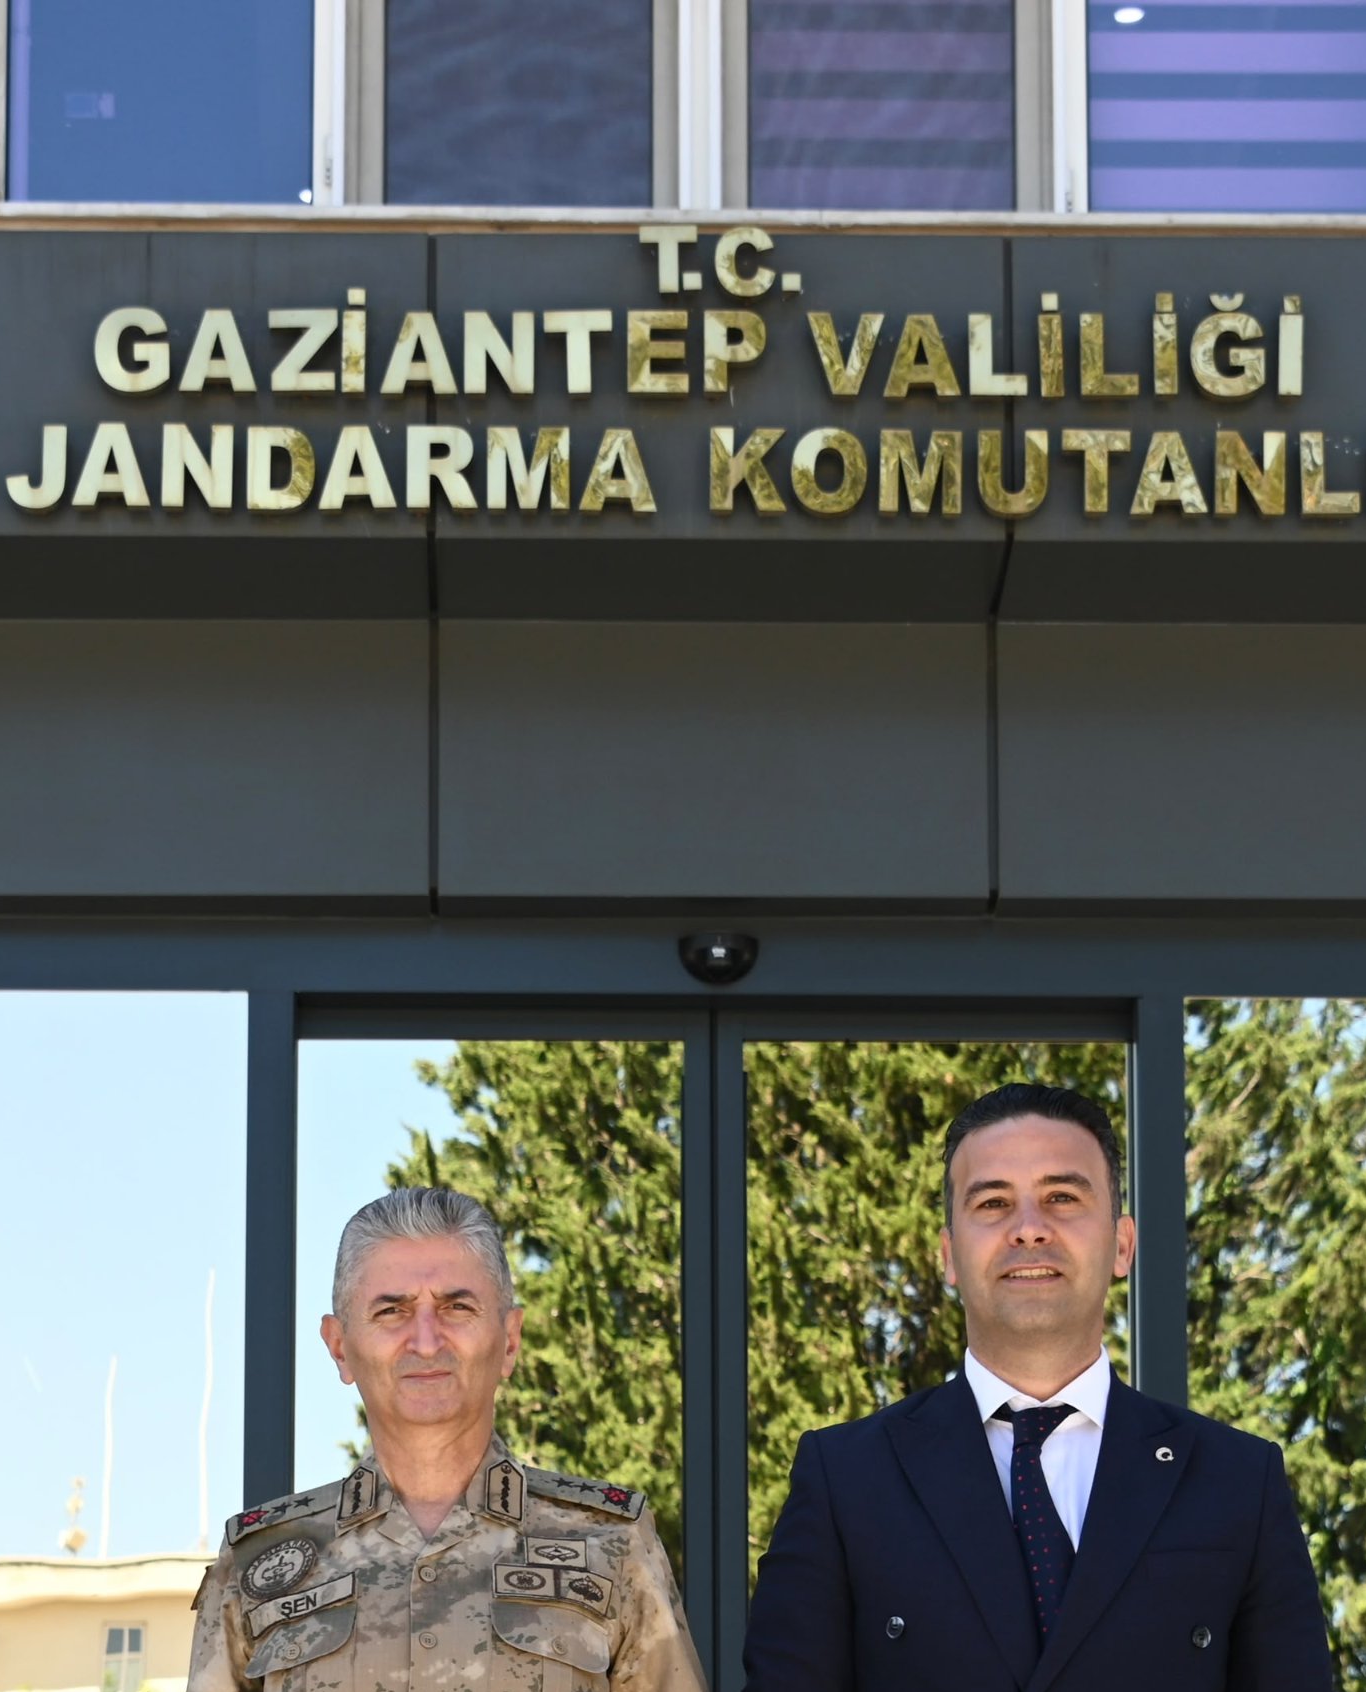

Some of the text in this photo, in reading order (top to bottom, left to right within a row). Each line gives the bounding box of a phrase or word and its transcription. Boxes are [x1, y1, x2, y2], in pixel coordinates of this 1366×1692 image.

[639, 226, 802, 297] T.C.
[92, 287, 1304, 399] GAZİANTEP VALİLİĞİ
[5, 422, 657, 514] JANDARMA
[280, 1592, 317, 1619] ŞEN
